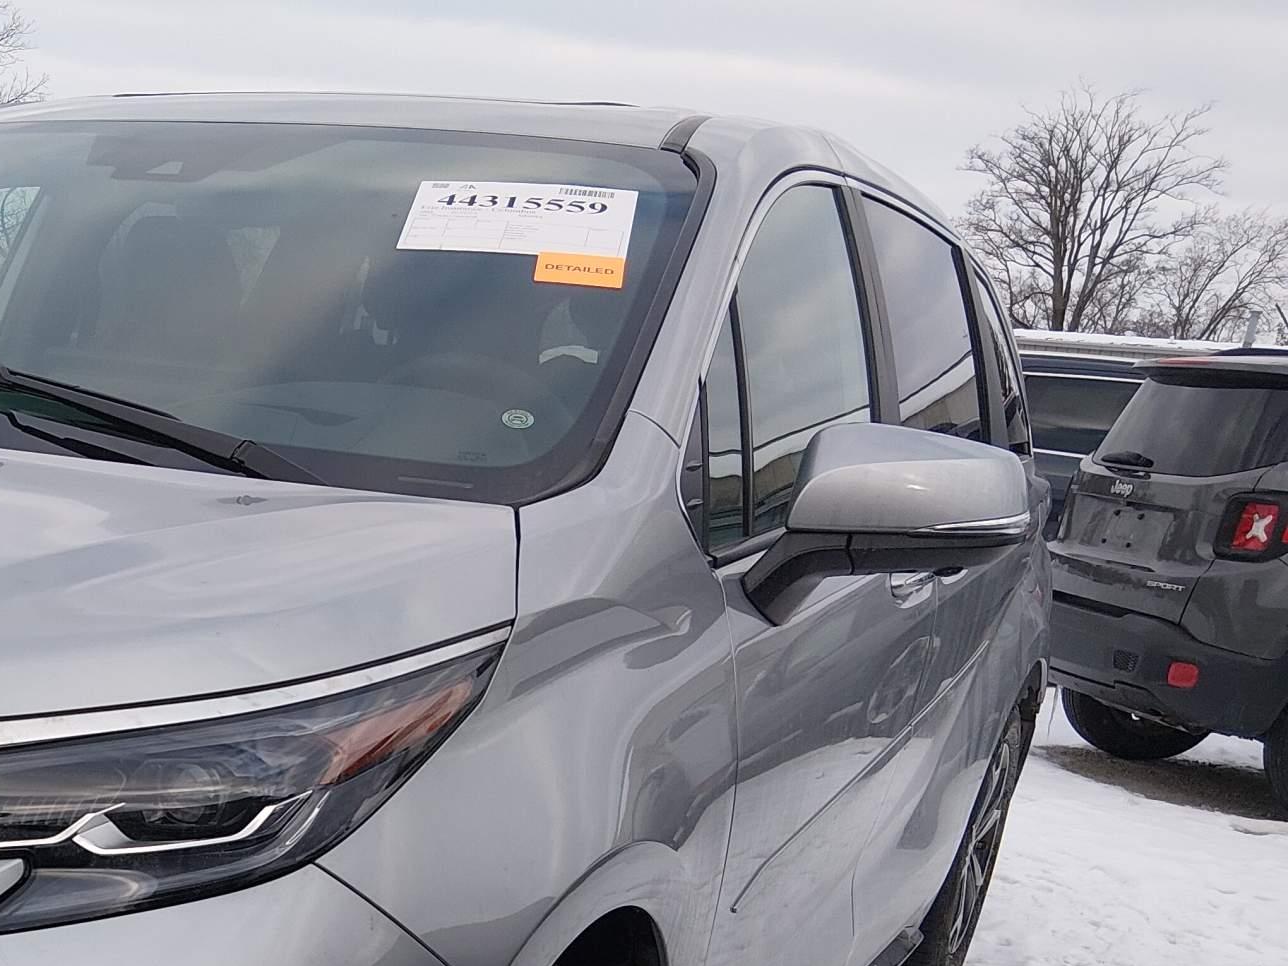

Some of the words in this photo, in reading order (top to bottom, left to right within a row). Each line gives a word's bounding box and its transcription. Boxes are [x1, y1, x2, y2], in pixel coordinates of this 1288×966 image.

[437, 194, 608, 214] 44315559
[545, 263, 614, 275] DETAILED
[1110, 479, 1133, 498] Jeep
[1146, 580, 1186, 592] SPORT
